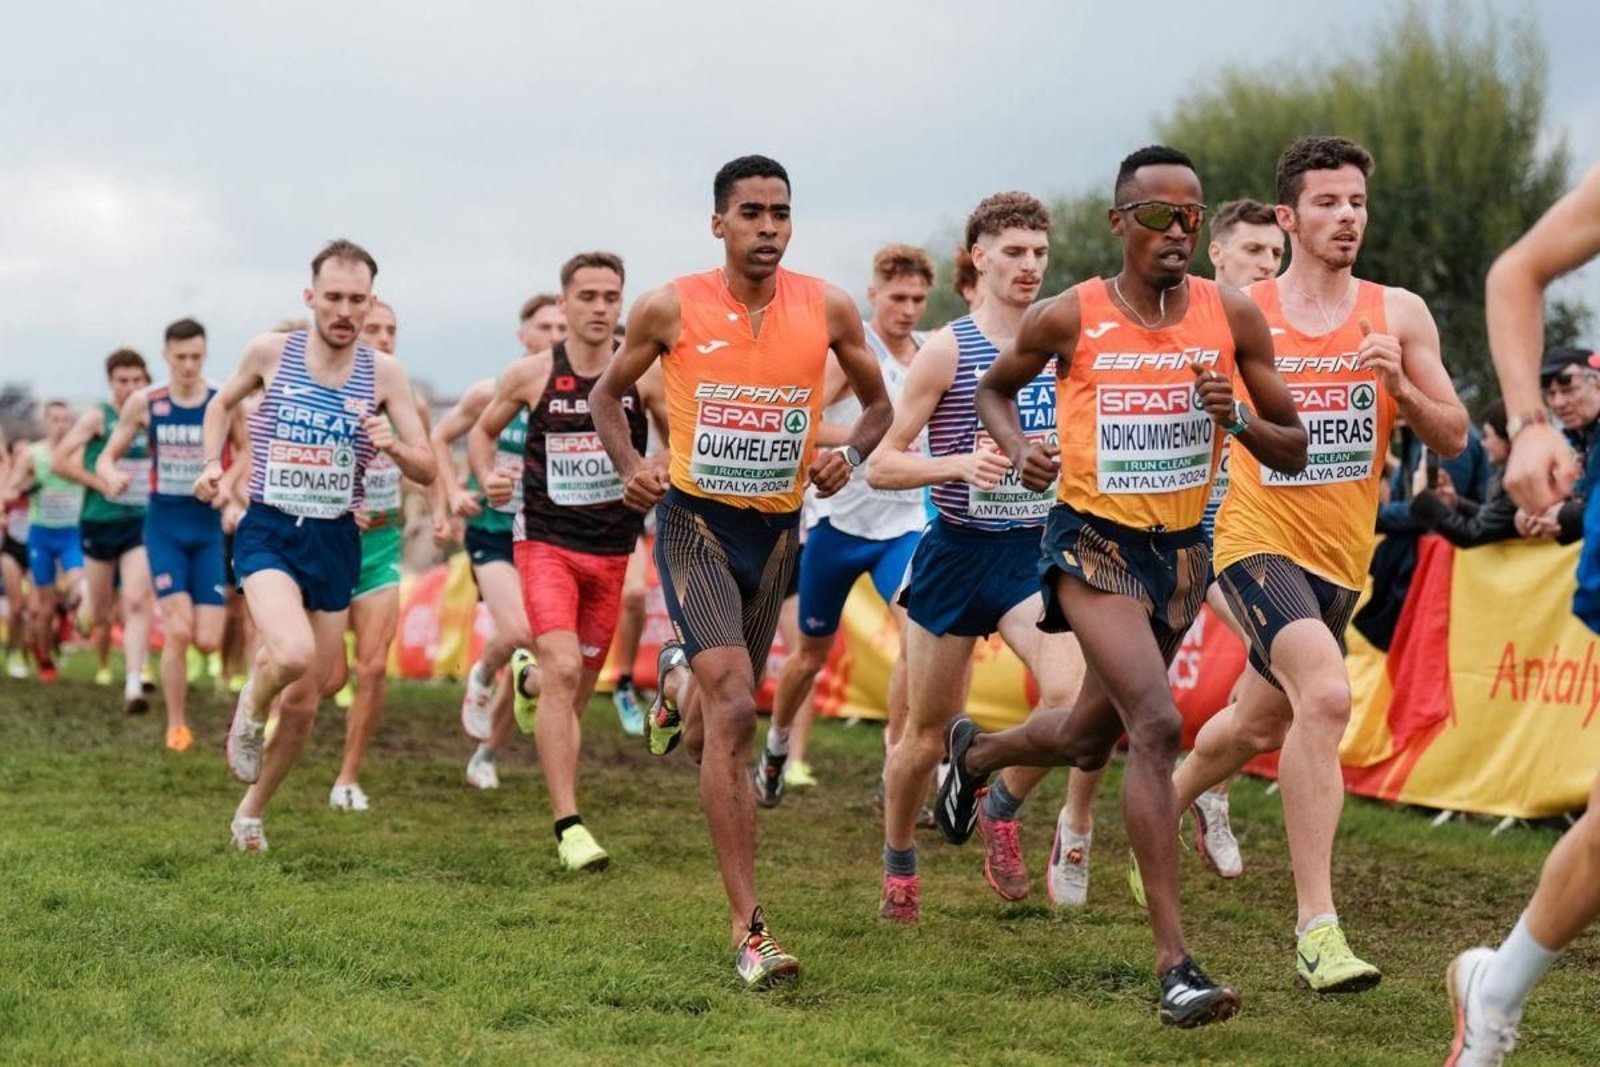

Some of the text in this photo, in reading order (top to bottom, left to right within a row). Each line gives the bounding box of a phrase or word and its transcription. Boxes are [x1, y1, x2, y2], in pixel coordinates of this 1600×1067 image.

[1092, 347, 1220, 371] ESPAÑA
[1275, 352, 1373, 374] SPAÑ
[695, 383, 812, 404] ESPAÑA
[1102, 390, 1188, 412] SPAR
[1291, 389, 1346, 408] PAR
[277, 404, 359, 436] GREAT
[703, 405, 781, 429] SPAR
[1101, 417, 1212, 451] NDIKUMWENAYO
[1309, 417, 1373, 445] HERAS
[271, 446, 331, 464] SPAR
[697, 433, 802, 461] OUKHELFEN
[551, 459, 616, 477] NIKOL
[1131, 461, 1157, 471] RUN
[1158, 458, 1191, 470] CLEAN
[1316, 452, 1350, 464] CLEAN
[269, 469, 350, 491] LEONARD
[720, 468, 742, 477] RUN
[743, 470, 775, 479] CLEAN
[1106, 469, 1206, 489] ANTALYA 2024
[1336, 465, 1368, 479] 2024
[696, 478, 789, 493] ANTALYA 2024
[275, 502, 319, 514] NTALYA
[974, 502, 1053, 516] ANTALYA 202
